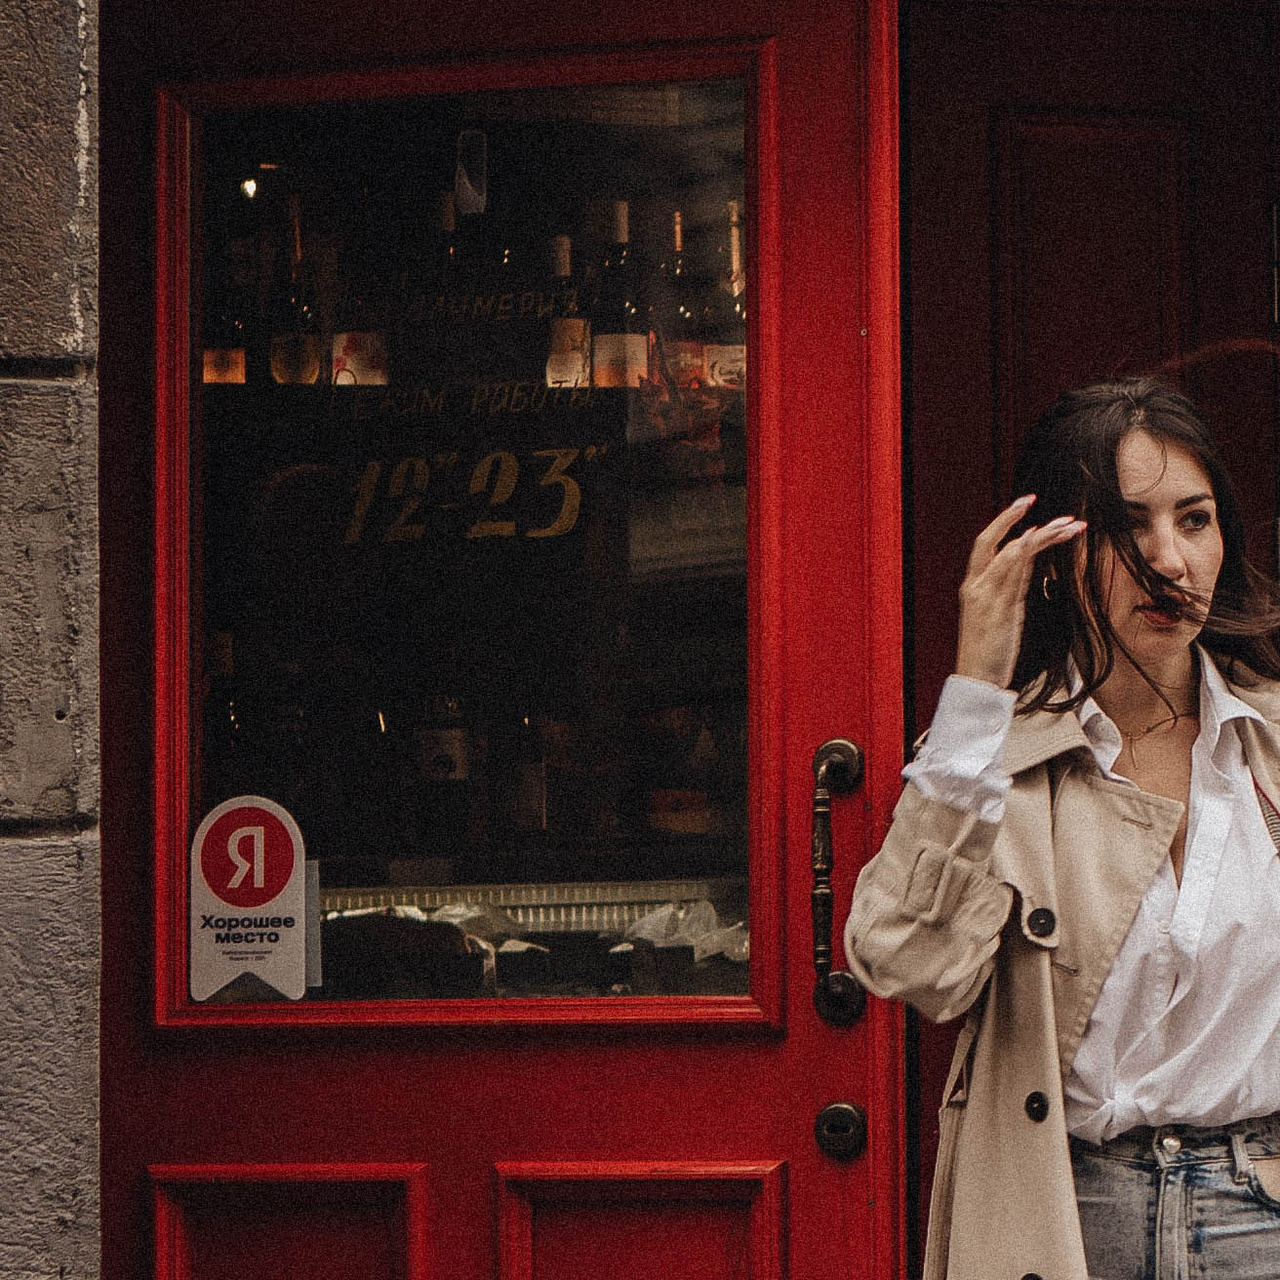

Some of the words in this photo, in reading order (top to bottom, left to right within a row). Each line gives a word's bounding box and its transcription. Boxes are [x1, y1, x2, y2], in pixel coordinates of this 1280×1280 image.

[226, 825, 265, 889] Я
[200, 914, 296, 932] Хорошее
[215, 931, 280, 944] место
